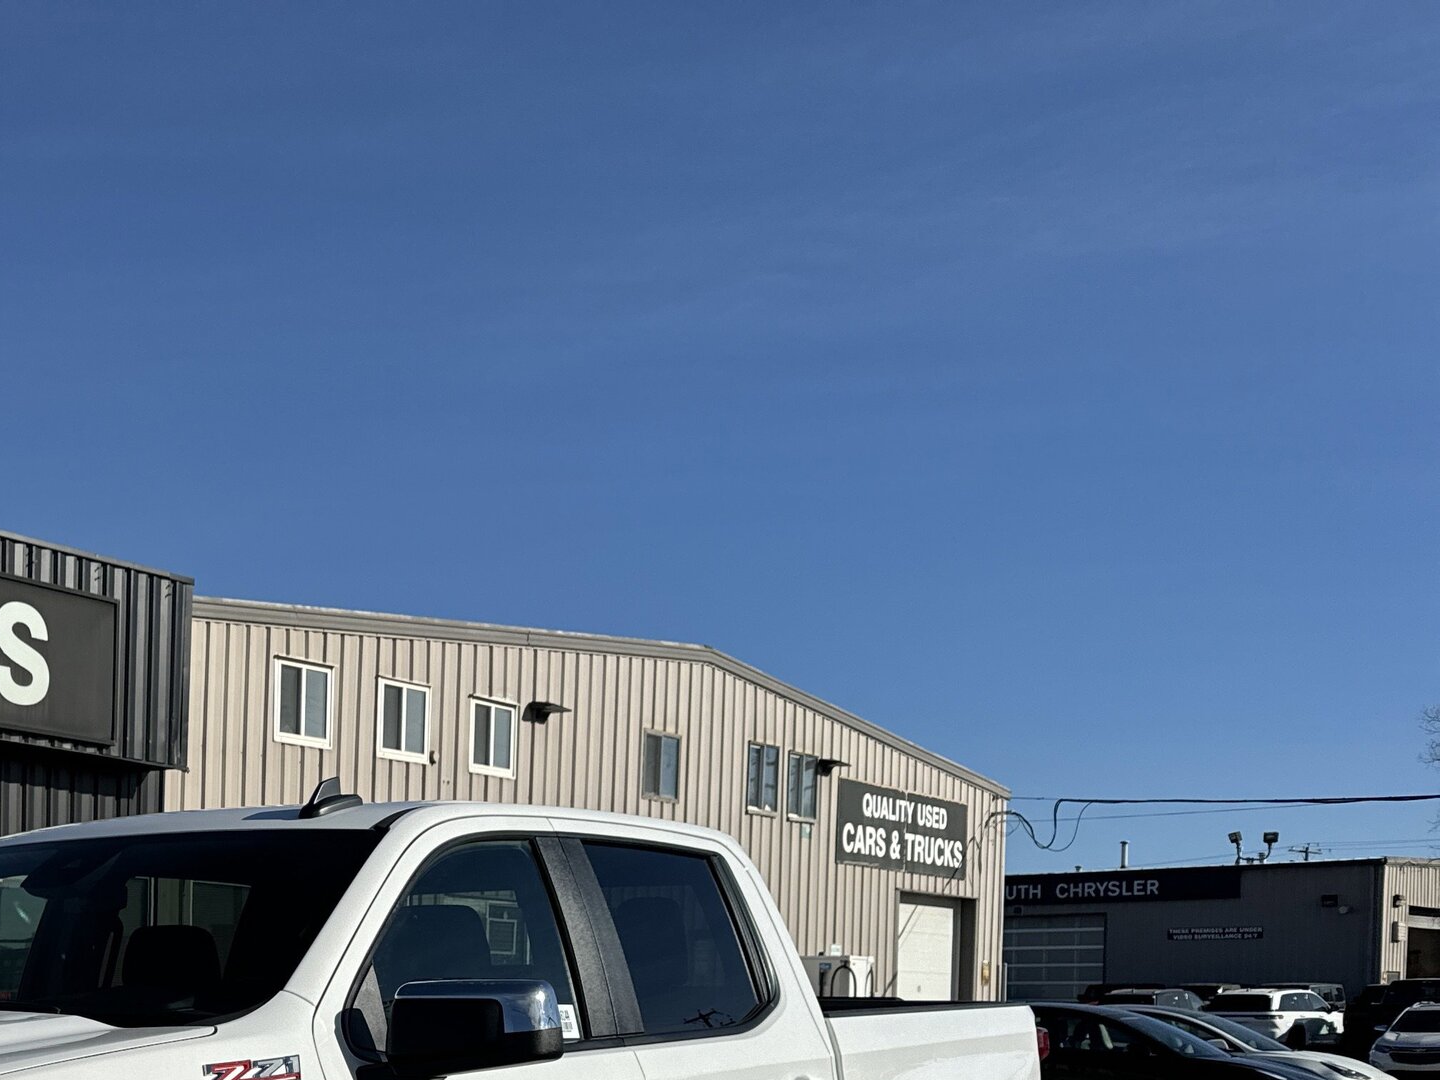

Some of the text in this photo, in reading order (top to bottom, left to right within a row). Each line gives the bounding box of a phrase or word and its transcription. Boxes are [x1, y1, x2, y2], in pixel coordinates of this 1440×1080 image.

[862, 793, 947, 830] QUALITY USED
[842, 822, 963, 868] CARS & TRUCKS
[1056, 880, 1160, 899] CHRYSLER
